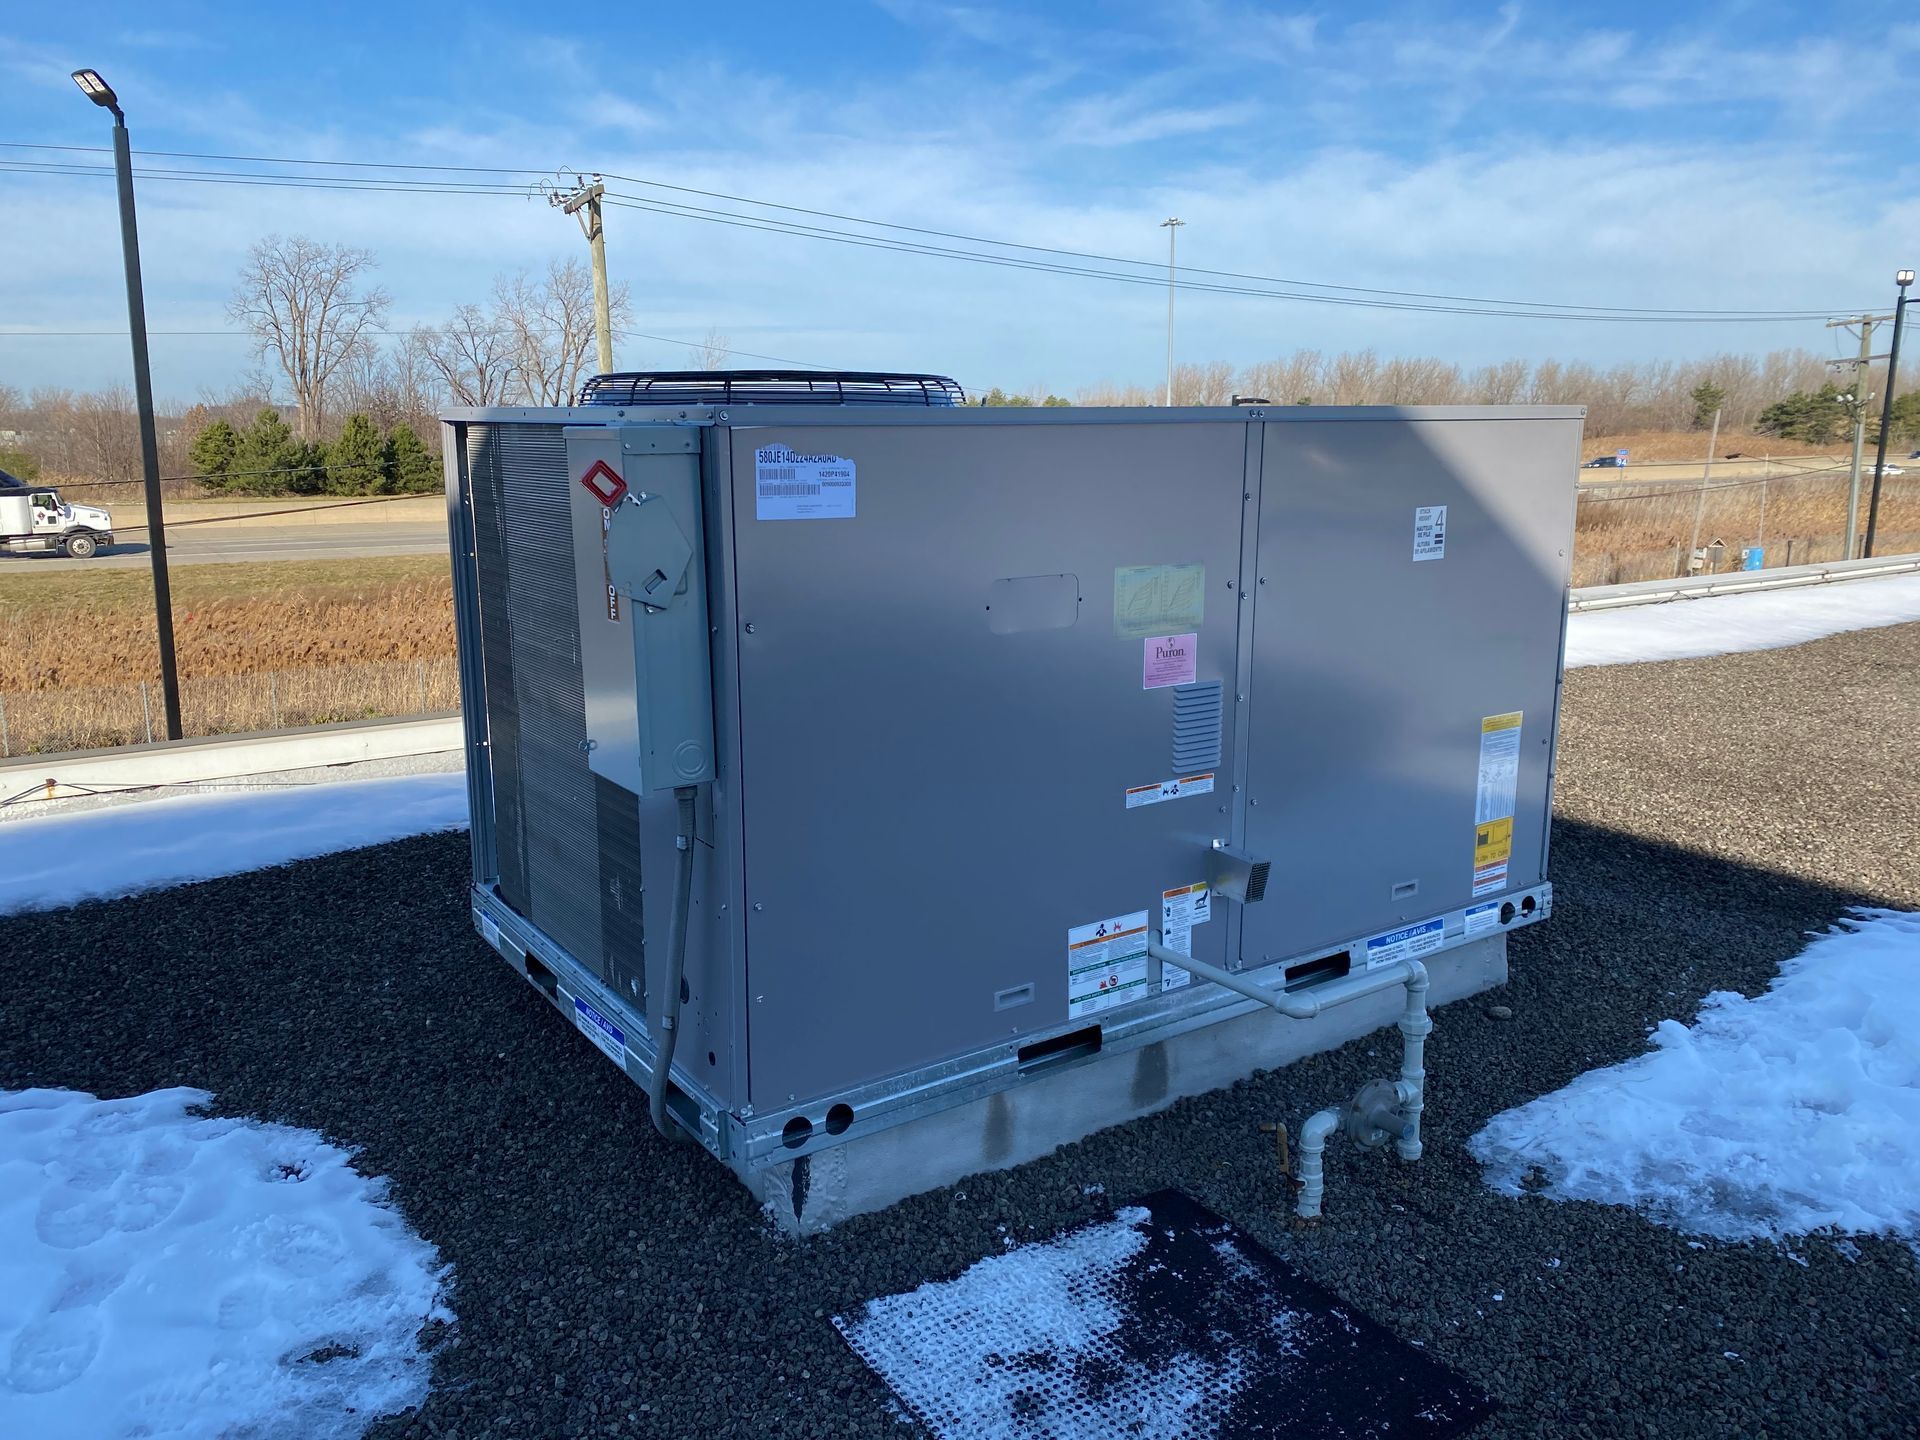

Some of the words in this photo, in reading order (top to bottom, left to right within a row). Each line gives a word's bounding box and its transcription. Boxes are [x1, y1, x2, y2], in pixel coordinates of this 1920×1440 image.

[1616, 458, 1627, 466] 94
[602, 508, 611, 531] ON
[1434, 510, 1444, 532] 4
[608, 584, 618, 620] OFF
[1156, 647, 1184, 659] Puron
